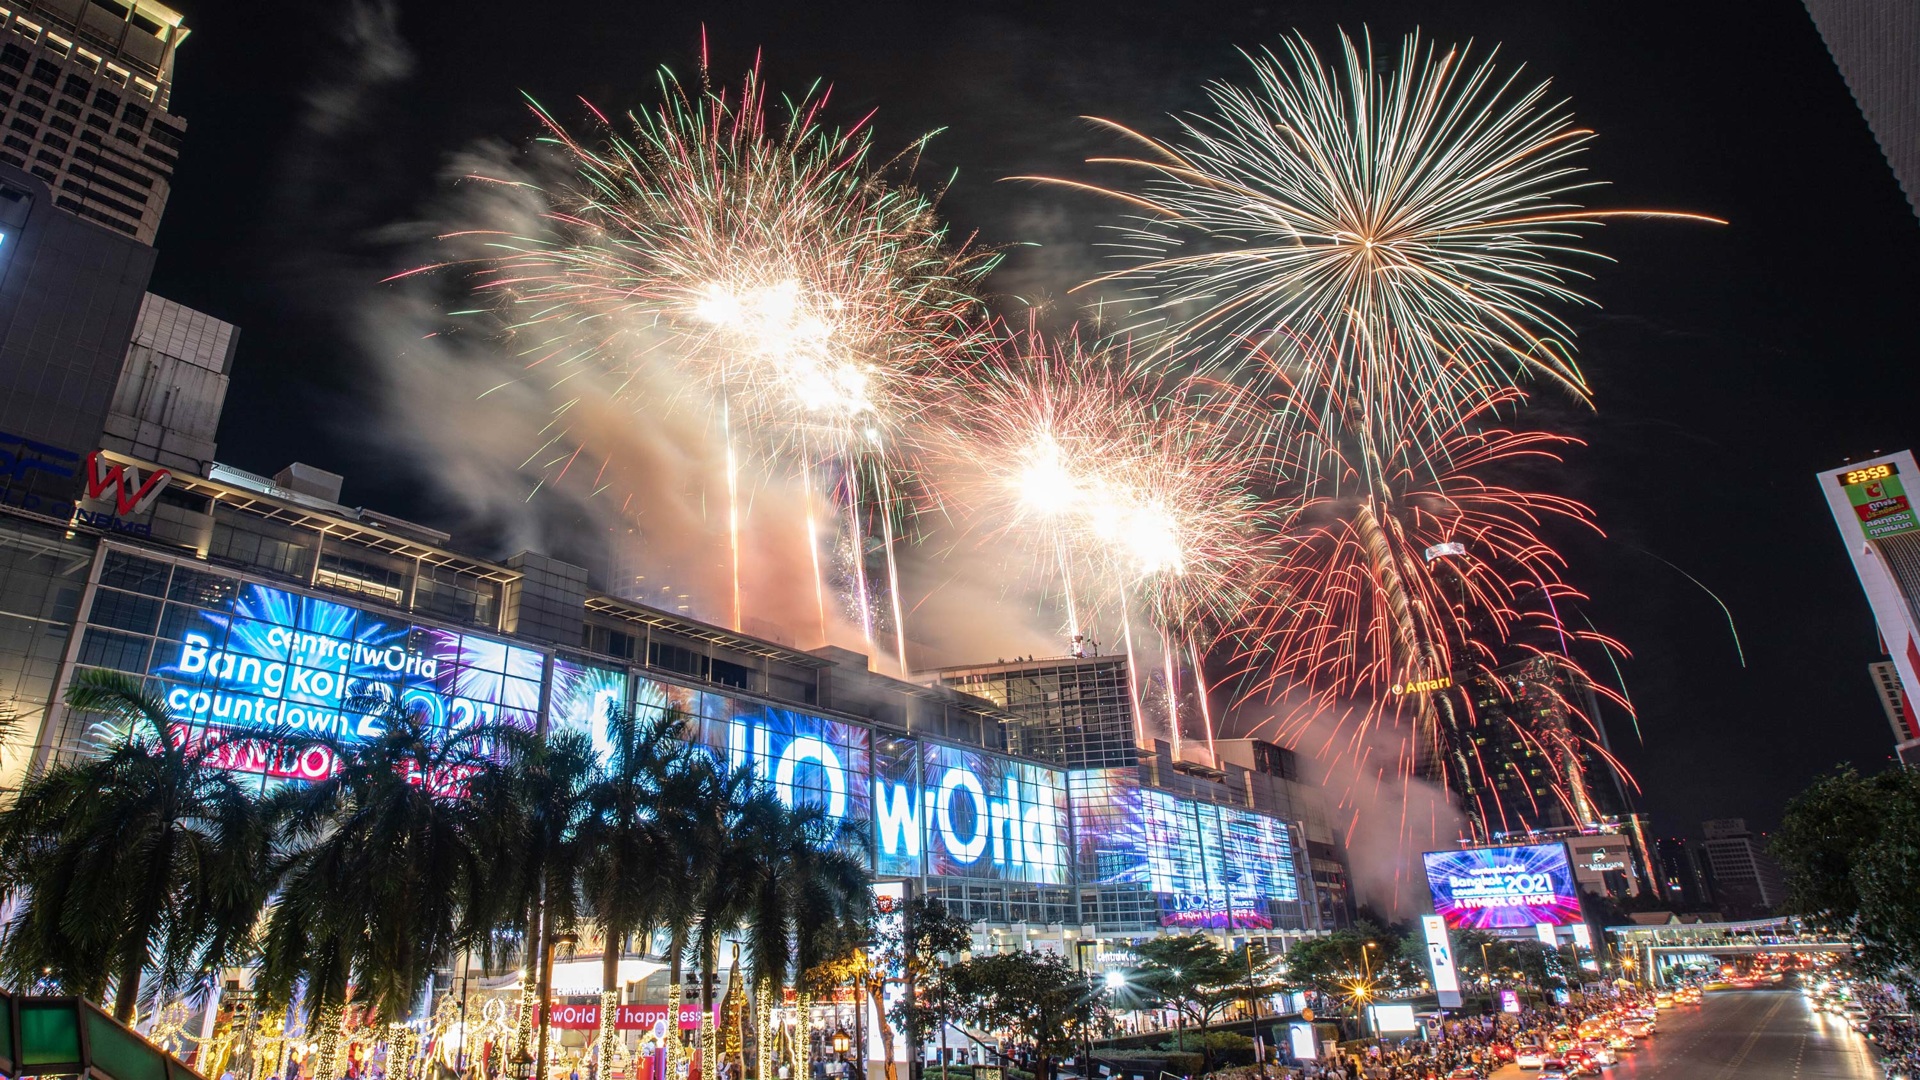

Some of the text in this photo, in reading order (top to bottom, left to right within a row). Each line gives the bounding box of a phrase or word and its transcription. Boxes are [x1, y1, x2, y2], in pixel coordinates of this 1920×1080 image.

[1847, 466, 1890, 484] 23:59
[179, 633, 356, 699] Bangkok
[1405, 677, 1451, 694] Amari
[168, 687, 349, 737] countdown
[875, 768, 1055, 871] wOrld
[1449, 874, 1505, 890] Bangkok
[1505, 873, 1553, 894] 2021
[1454, 899, 1463, 908] A
[1508, 896, 1524, 906] OF
[1526, 894, 1557, 905] HOPE
[552, 1007, 596, 1023] wOrld
